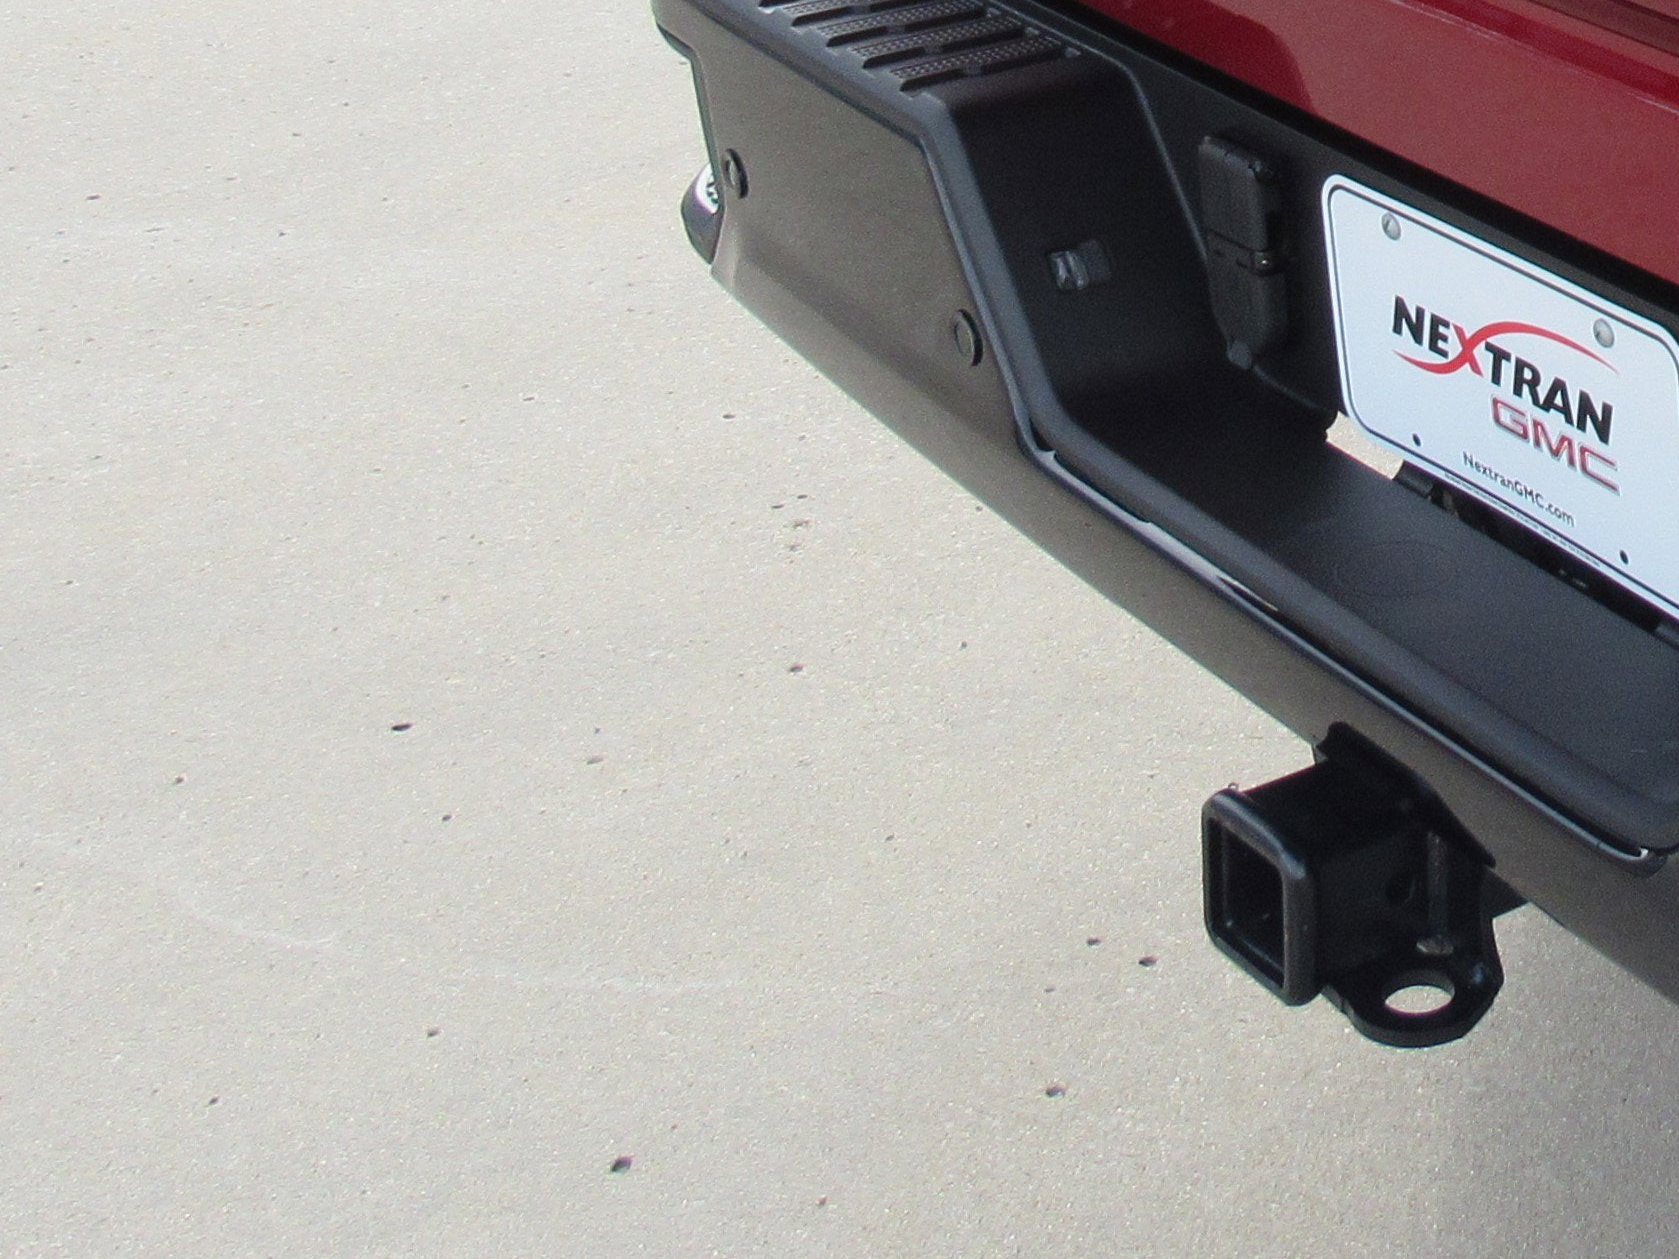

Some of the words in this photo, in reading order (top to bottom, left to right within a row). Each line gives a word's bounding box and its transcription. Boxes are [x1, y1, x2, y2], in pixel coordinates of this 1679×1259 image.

[1391, 294, 1614, 446] NEXTRAN
[1462, 450, 1576, 528] NextranGMC.com
[1490, 393, 1621, 496] GMC
